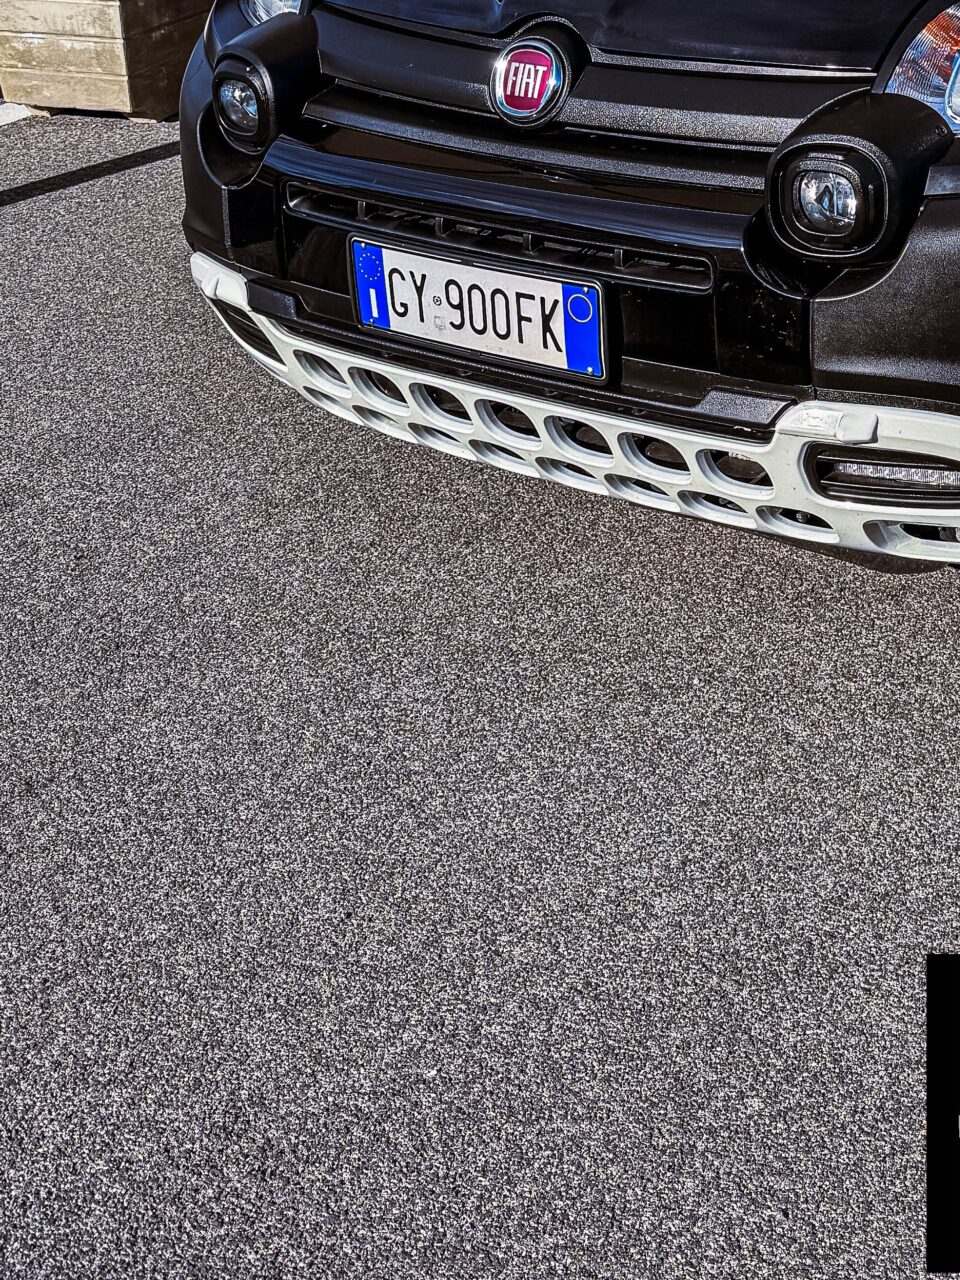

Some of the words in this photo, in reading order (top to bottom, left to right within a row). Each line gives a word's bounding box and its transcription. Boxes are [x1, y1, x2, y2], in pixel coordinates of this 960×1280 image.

[506, 61, 548, 99] FIAT
[388, 267, 427, 323] GY
[444, 278, 563, 353] 900FK
